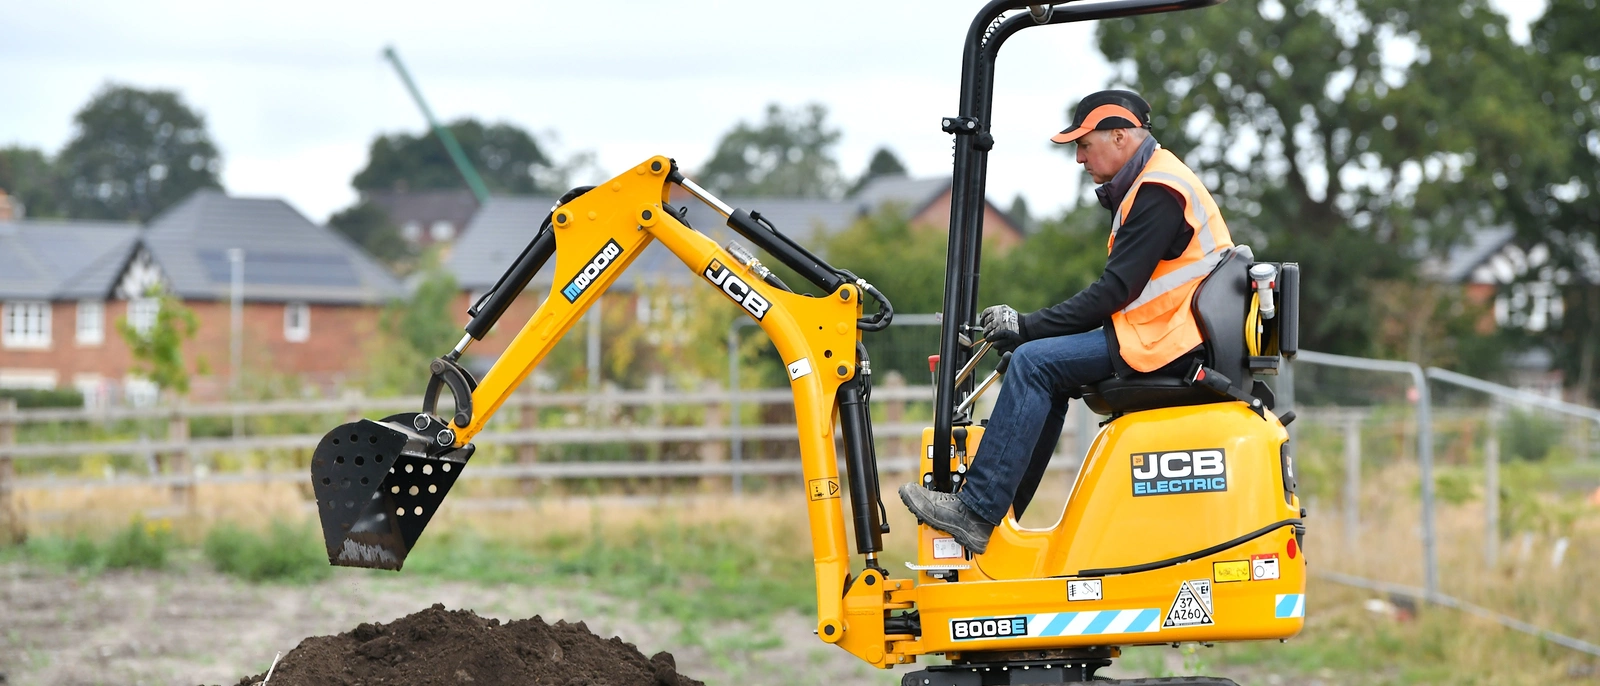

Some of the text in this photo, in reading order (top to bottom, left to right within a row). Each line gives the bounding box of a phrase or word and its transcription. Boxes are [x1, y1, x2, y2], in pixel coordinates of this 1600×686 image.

[563, 243, 619, 300] 8008E
[706, 269, 768, 318] JCB
[1133, 451, 1224, 479] JCB
[1134, 478, 1225, 494] ELECTRIC
[1180, 598, 1192, 608] 37
[1174, 609, 1200, 620] AZ60
[955, 619, 1025, 637] 8008E
